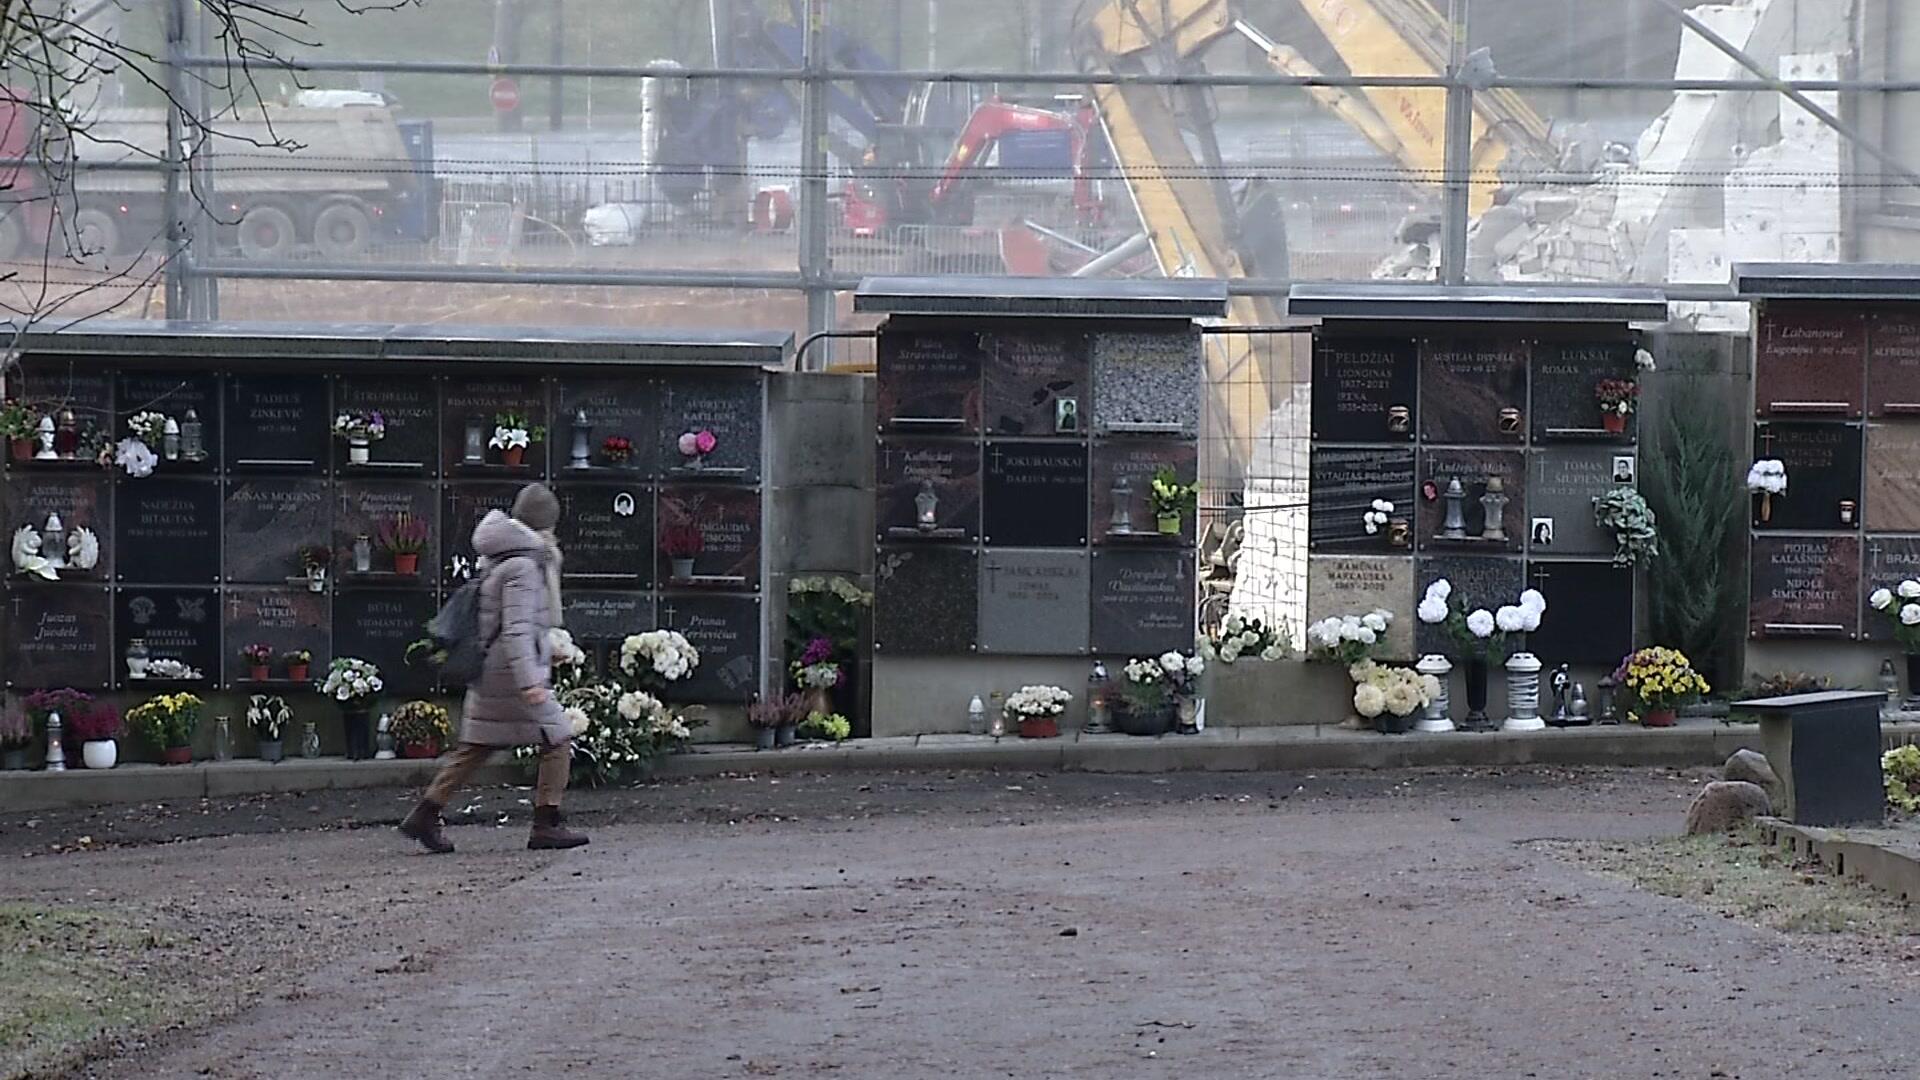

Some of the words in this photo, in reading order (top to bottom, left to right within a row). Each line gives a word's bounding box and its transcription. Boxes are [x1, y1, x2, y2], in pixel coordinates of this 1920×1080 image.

[1335, 351, 1395, 364] PELDŽIAI
[37, 611, 77, 626] Juozas
[256, 607, 298, 618] VETKIN
[690, 615, 727, 627] Pranas
